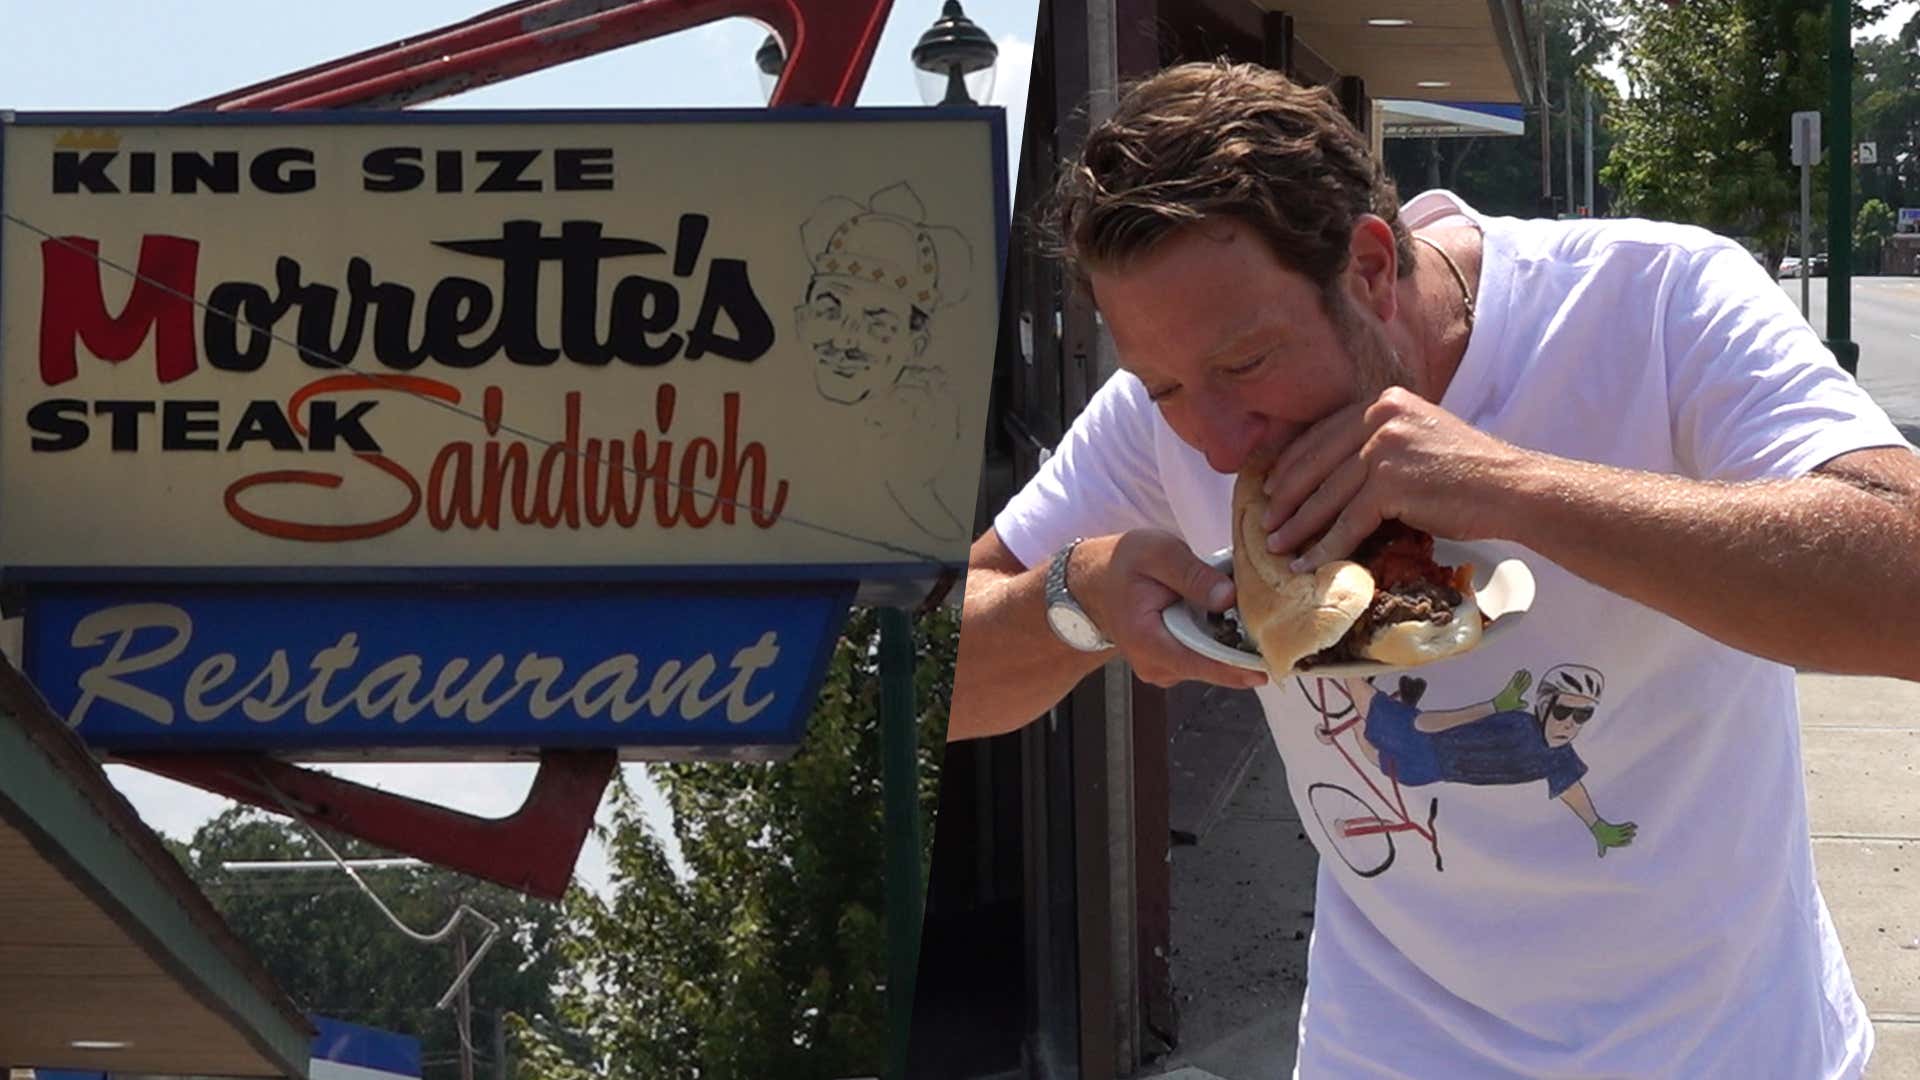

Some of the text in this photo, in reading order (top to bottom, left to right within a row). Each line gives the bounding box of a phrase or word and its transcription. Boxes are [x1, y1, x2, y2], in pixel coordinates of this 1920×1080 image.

[53, 147, 614, 194] KING SIZE
[39, 213, 776, 386] Morrette's
[26, 373, 789, 542] STEAK Sandwich
[67, 602, 780, 729] Restaurant
